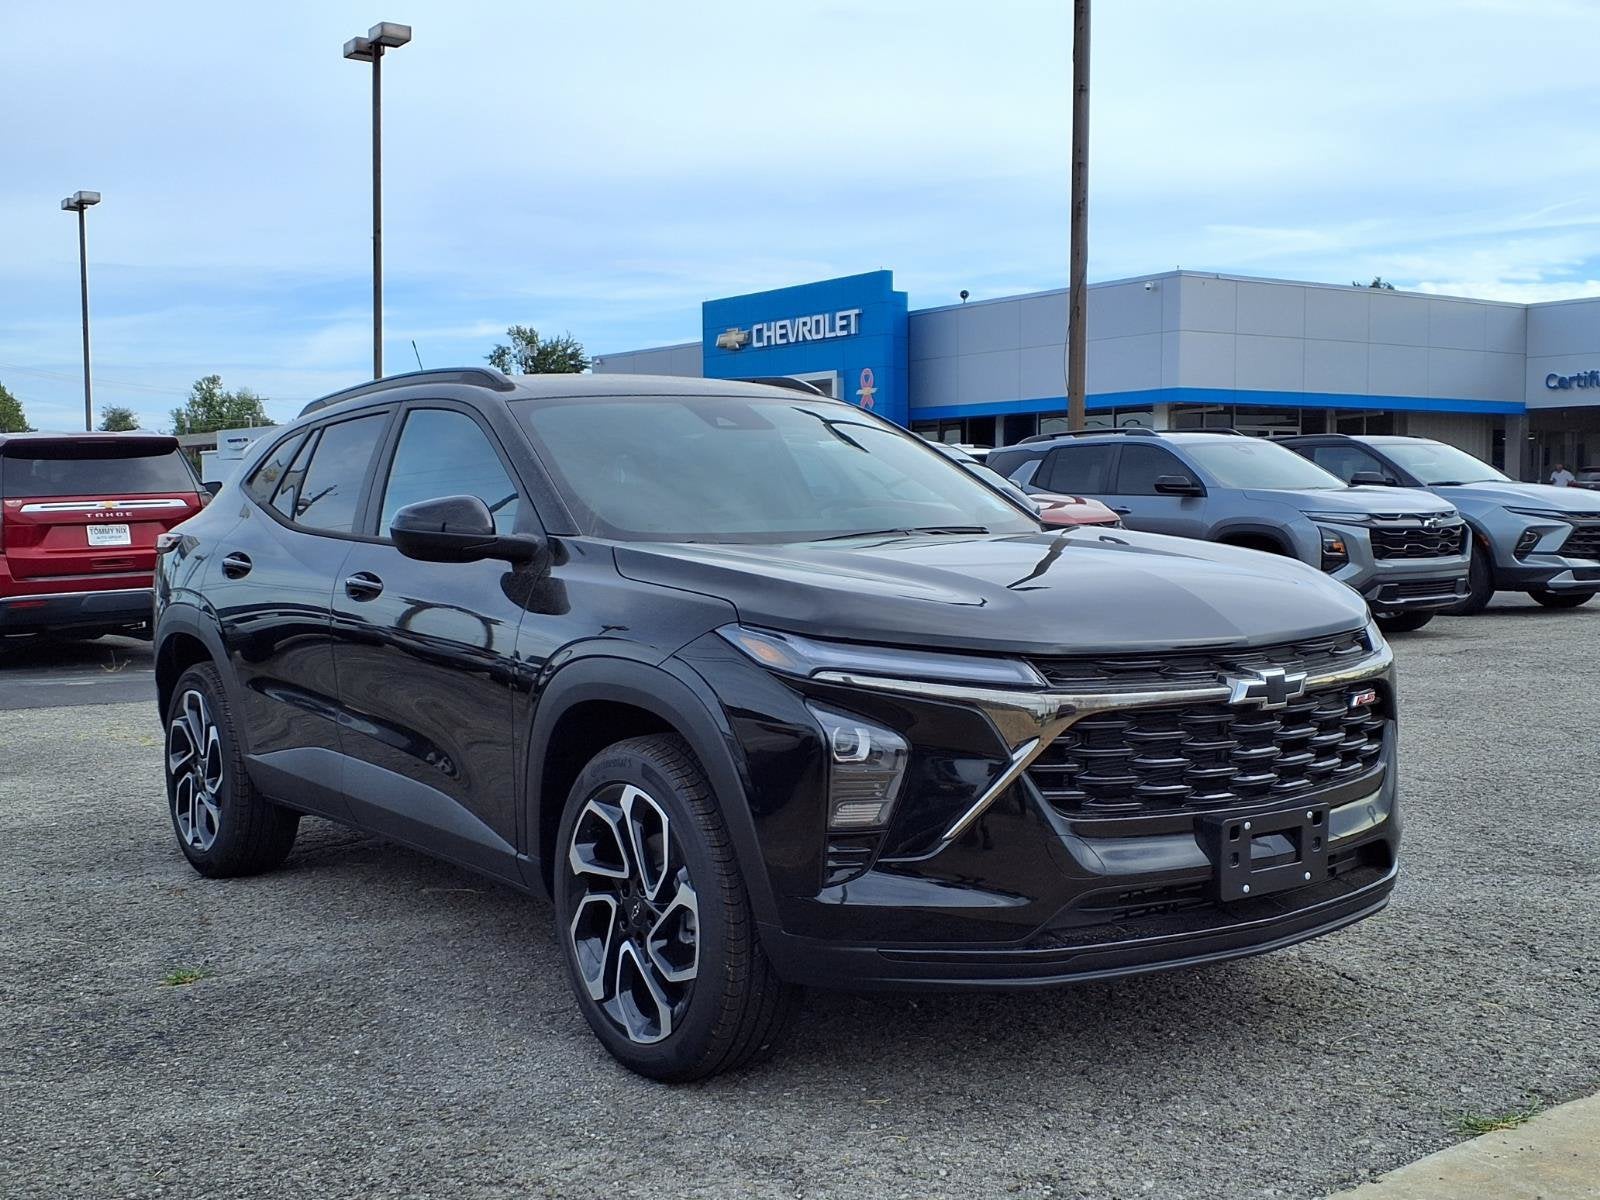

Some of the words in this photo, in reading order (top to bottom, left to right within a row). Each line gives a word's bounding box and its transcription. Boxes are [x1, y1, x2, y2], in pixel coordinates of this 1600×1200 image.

[752, 308, 862, 348] CHEVROLET
[89, 527, 114, 536] TOMMY
[1352, 690, 1376, 706] RS
